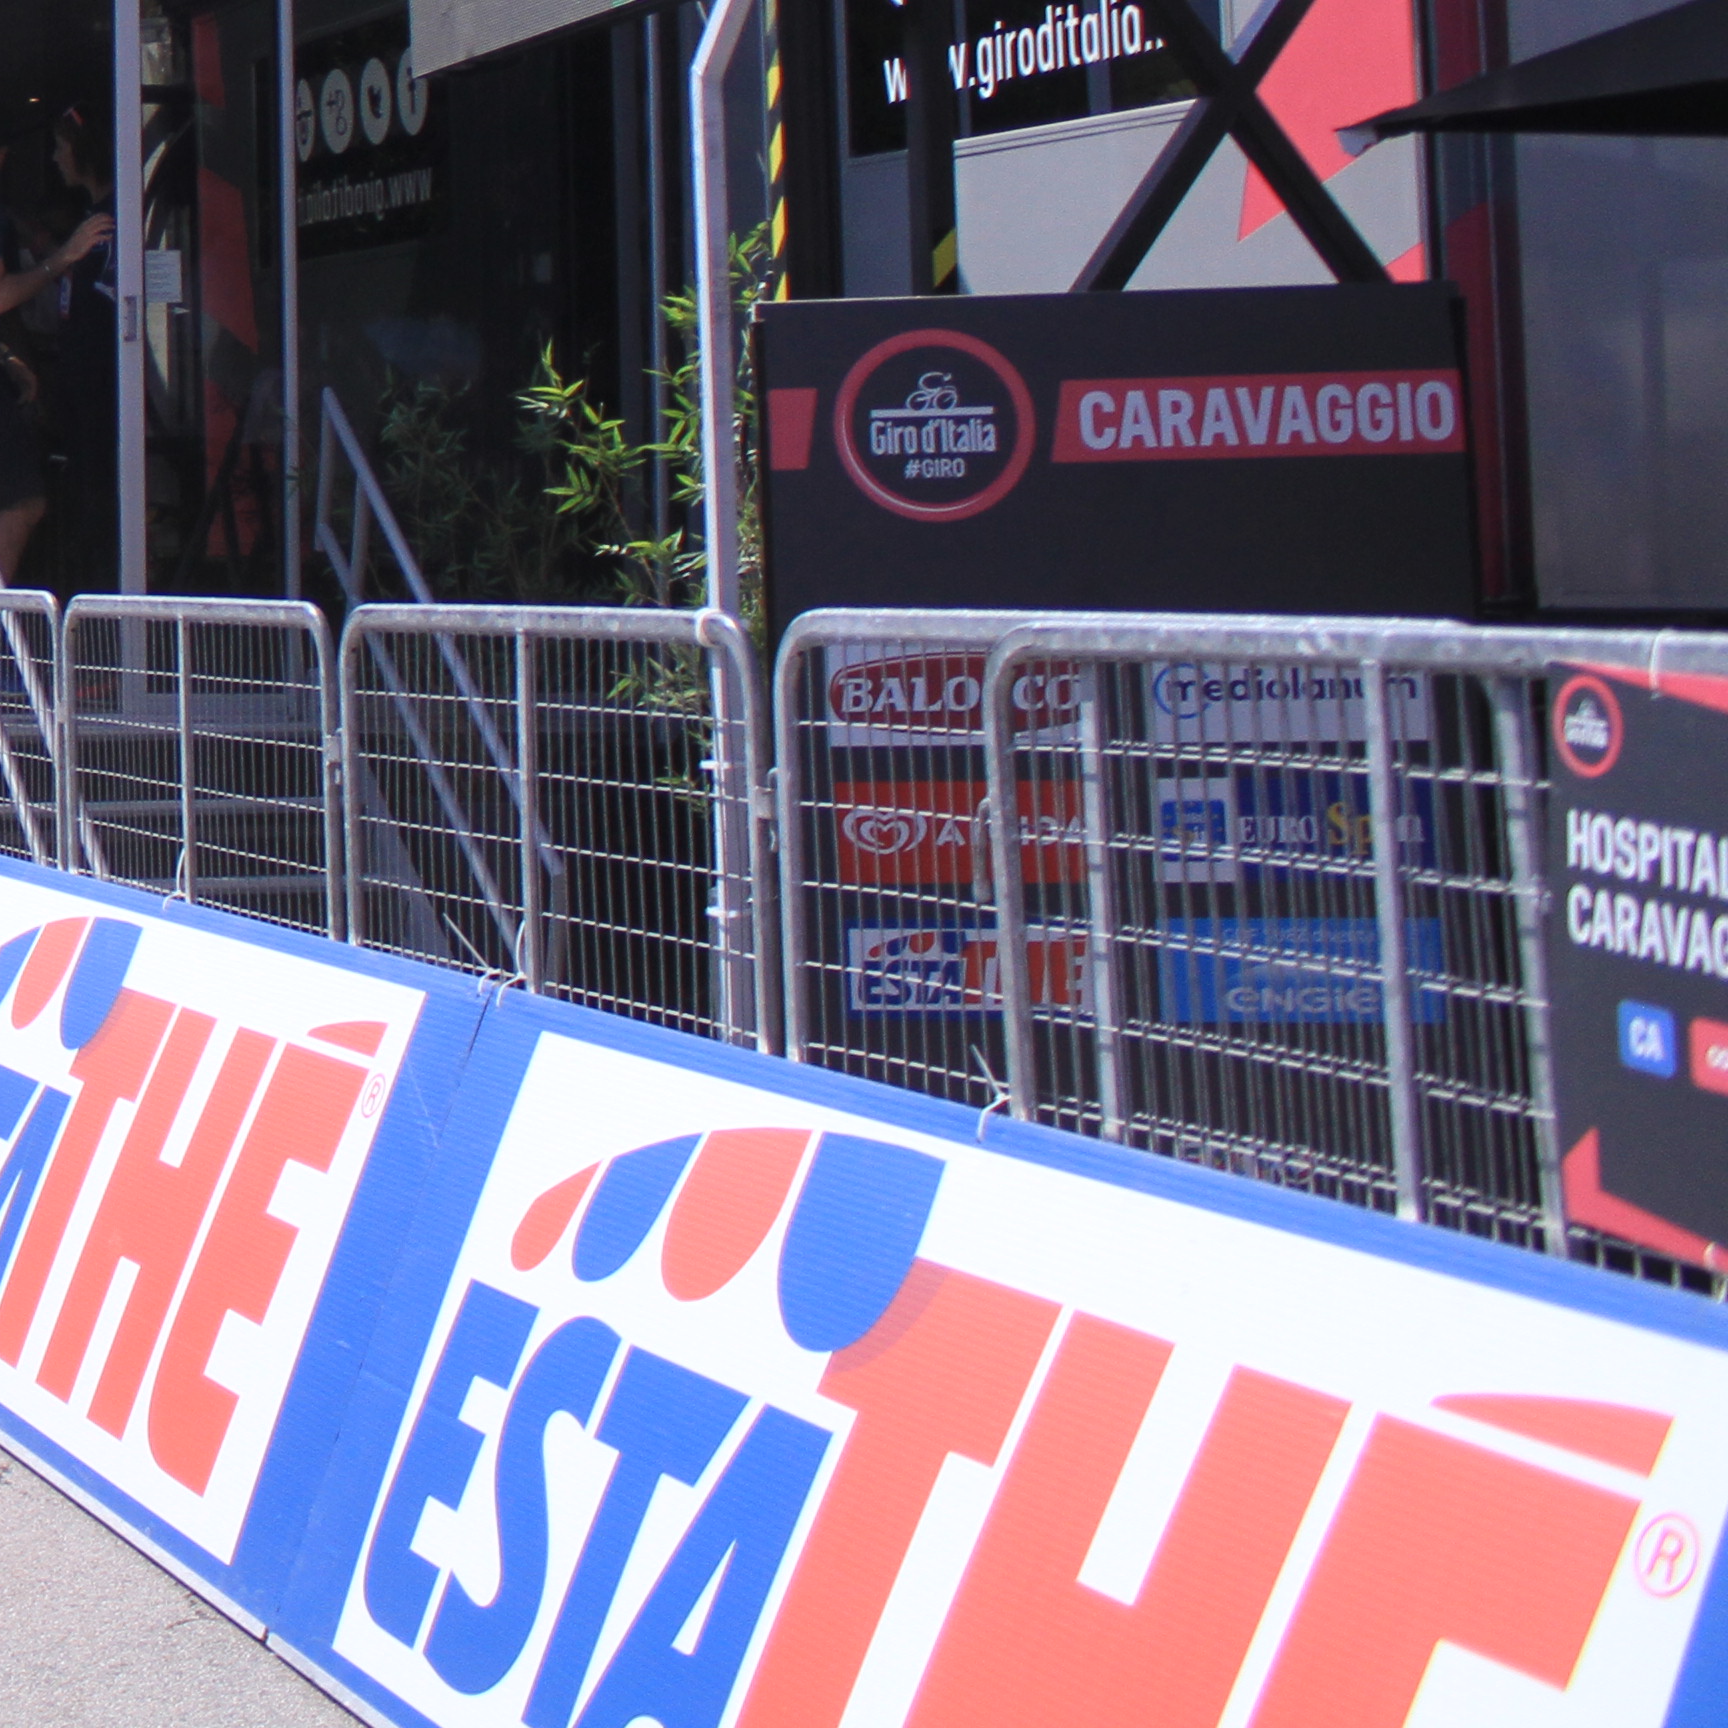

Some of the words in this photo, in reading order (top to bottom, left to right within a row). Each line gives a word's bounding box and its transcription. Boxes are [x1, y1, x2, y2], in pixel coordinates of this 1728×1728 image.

[1078, 381, 1456, 450] CARAVAGGIO
[869, 418, 919, 455] Giro
[921, 418, 996, 454] d'Italia
[903, 458, 965, 479] #GIRO
